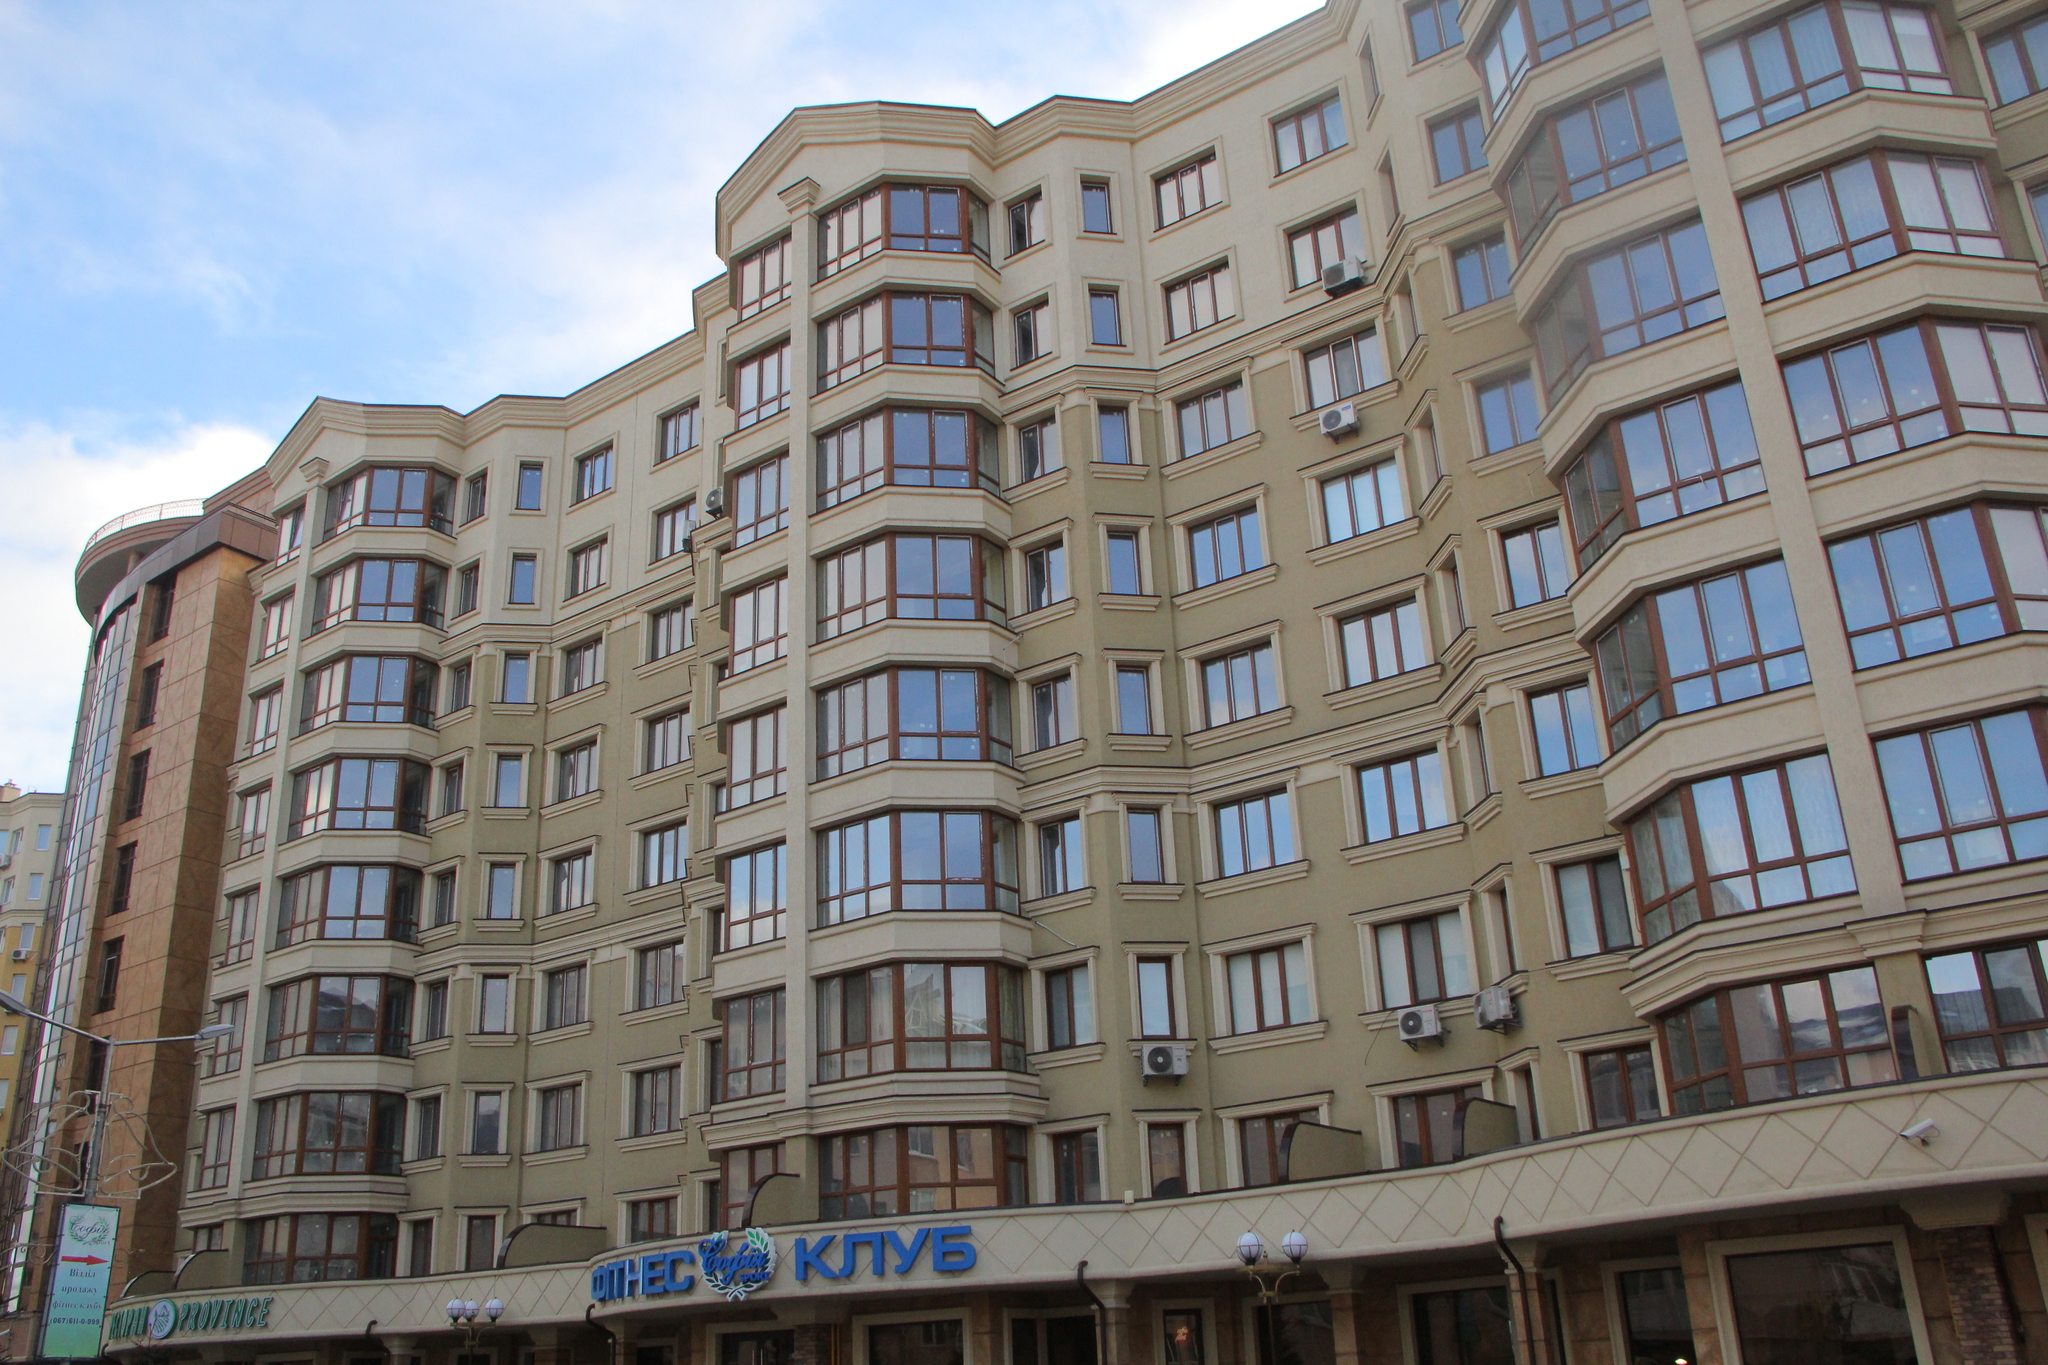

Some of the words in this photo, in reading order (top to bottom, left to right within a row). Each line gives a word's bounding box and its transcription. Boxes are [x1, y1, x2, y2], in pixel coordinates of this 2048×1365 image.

[590, 1249, 695, 1303] ФІТНЕС
[794, 1224, 977, 1282] КЛУБ
[738, 1271, 772, 1283] SPORT
[61, 1285, 98, 1295] продажу
[177, 1296, 274, 1331] PROVINCE
